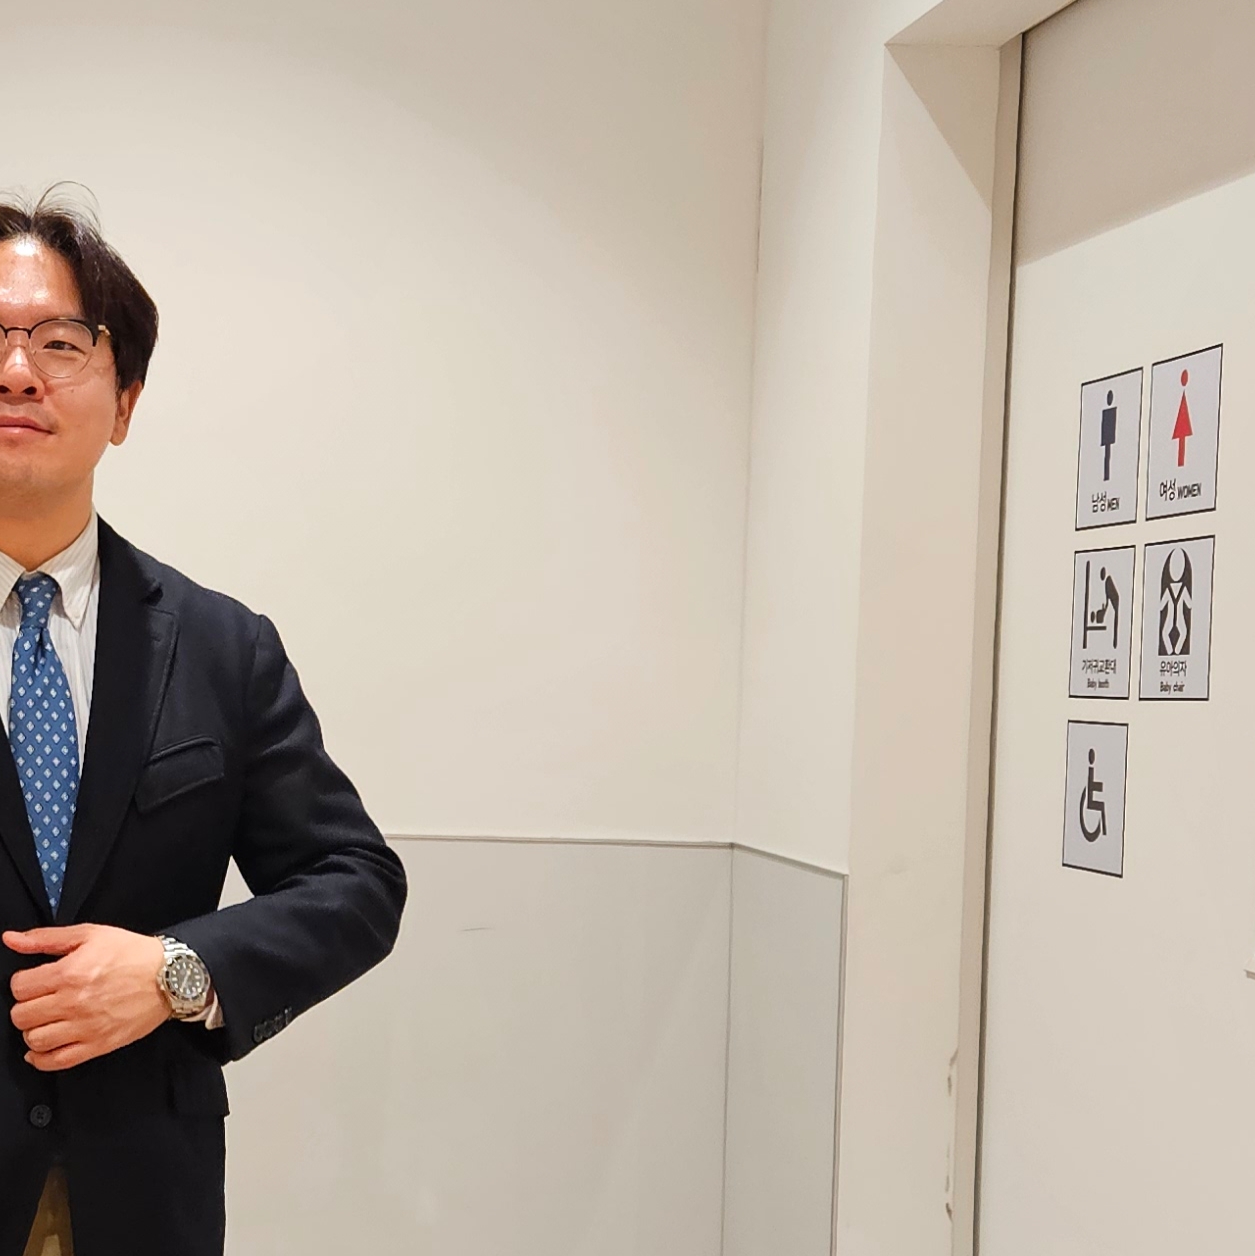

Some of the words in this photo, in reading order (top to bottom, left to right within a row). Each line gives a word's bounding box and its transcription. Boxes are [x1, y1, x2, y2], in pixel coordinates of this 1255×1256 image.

[1159, 478, 1177, 501] 여성
[1177, 482, 1202, 500] WOMEN
[1091, 491, 1107, 513] 남성
[1107, 497, 1120, 511] MEN
[1159, 660, 1187, 677] 유아의자
[1159, 680, 1172, 695] Baby
[1173, 680, 1185, 692] chair
